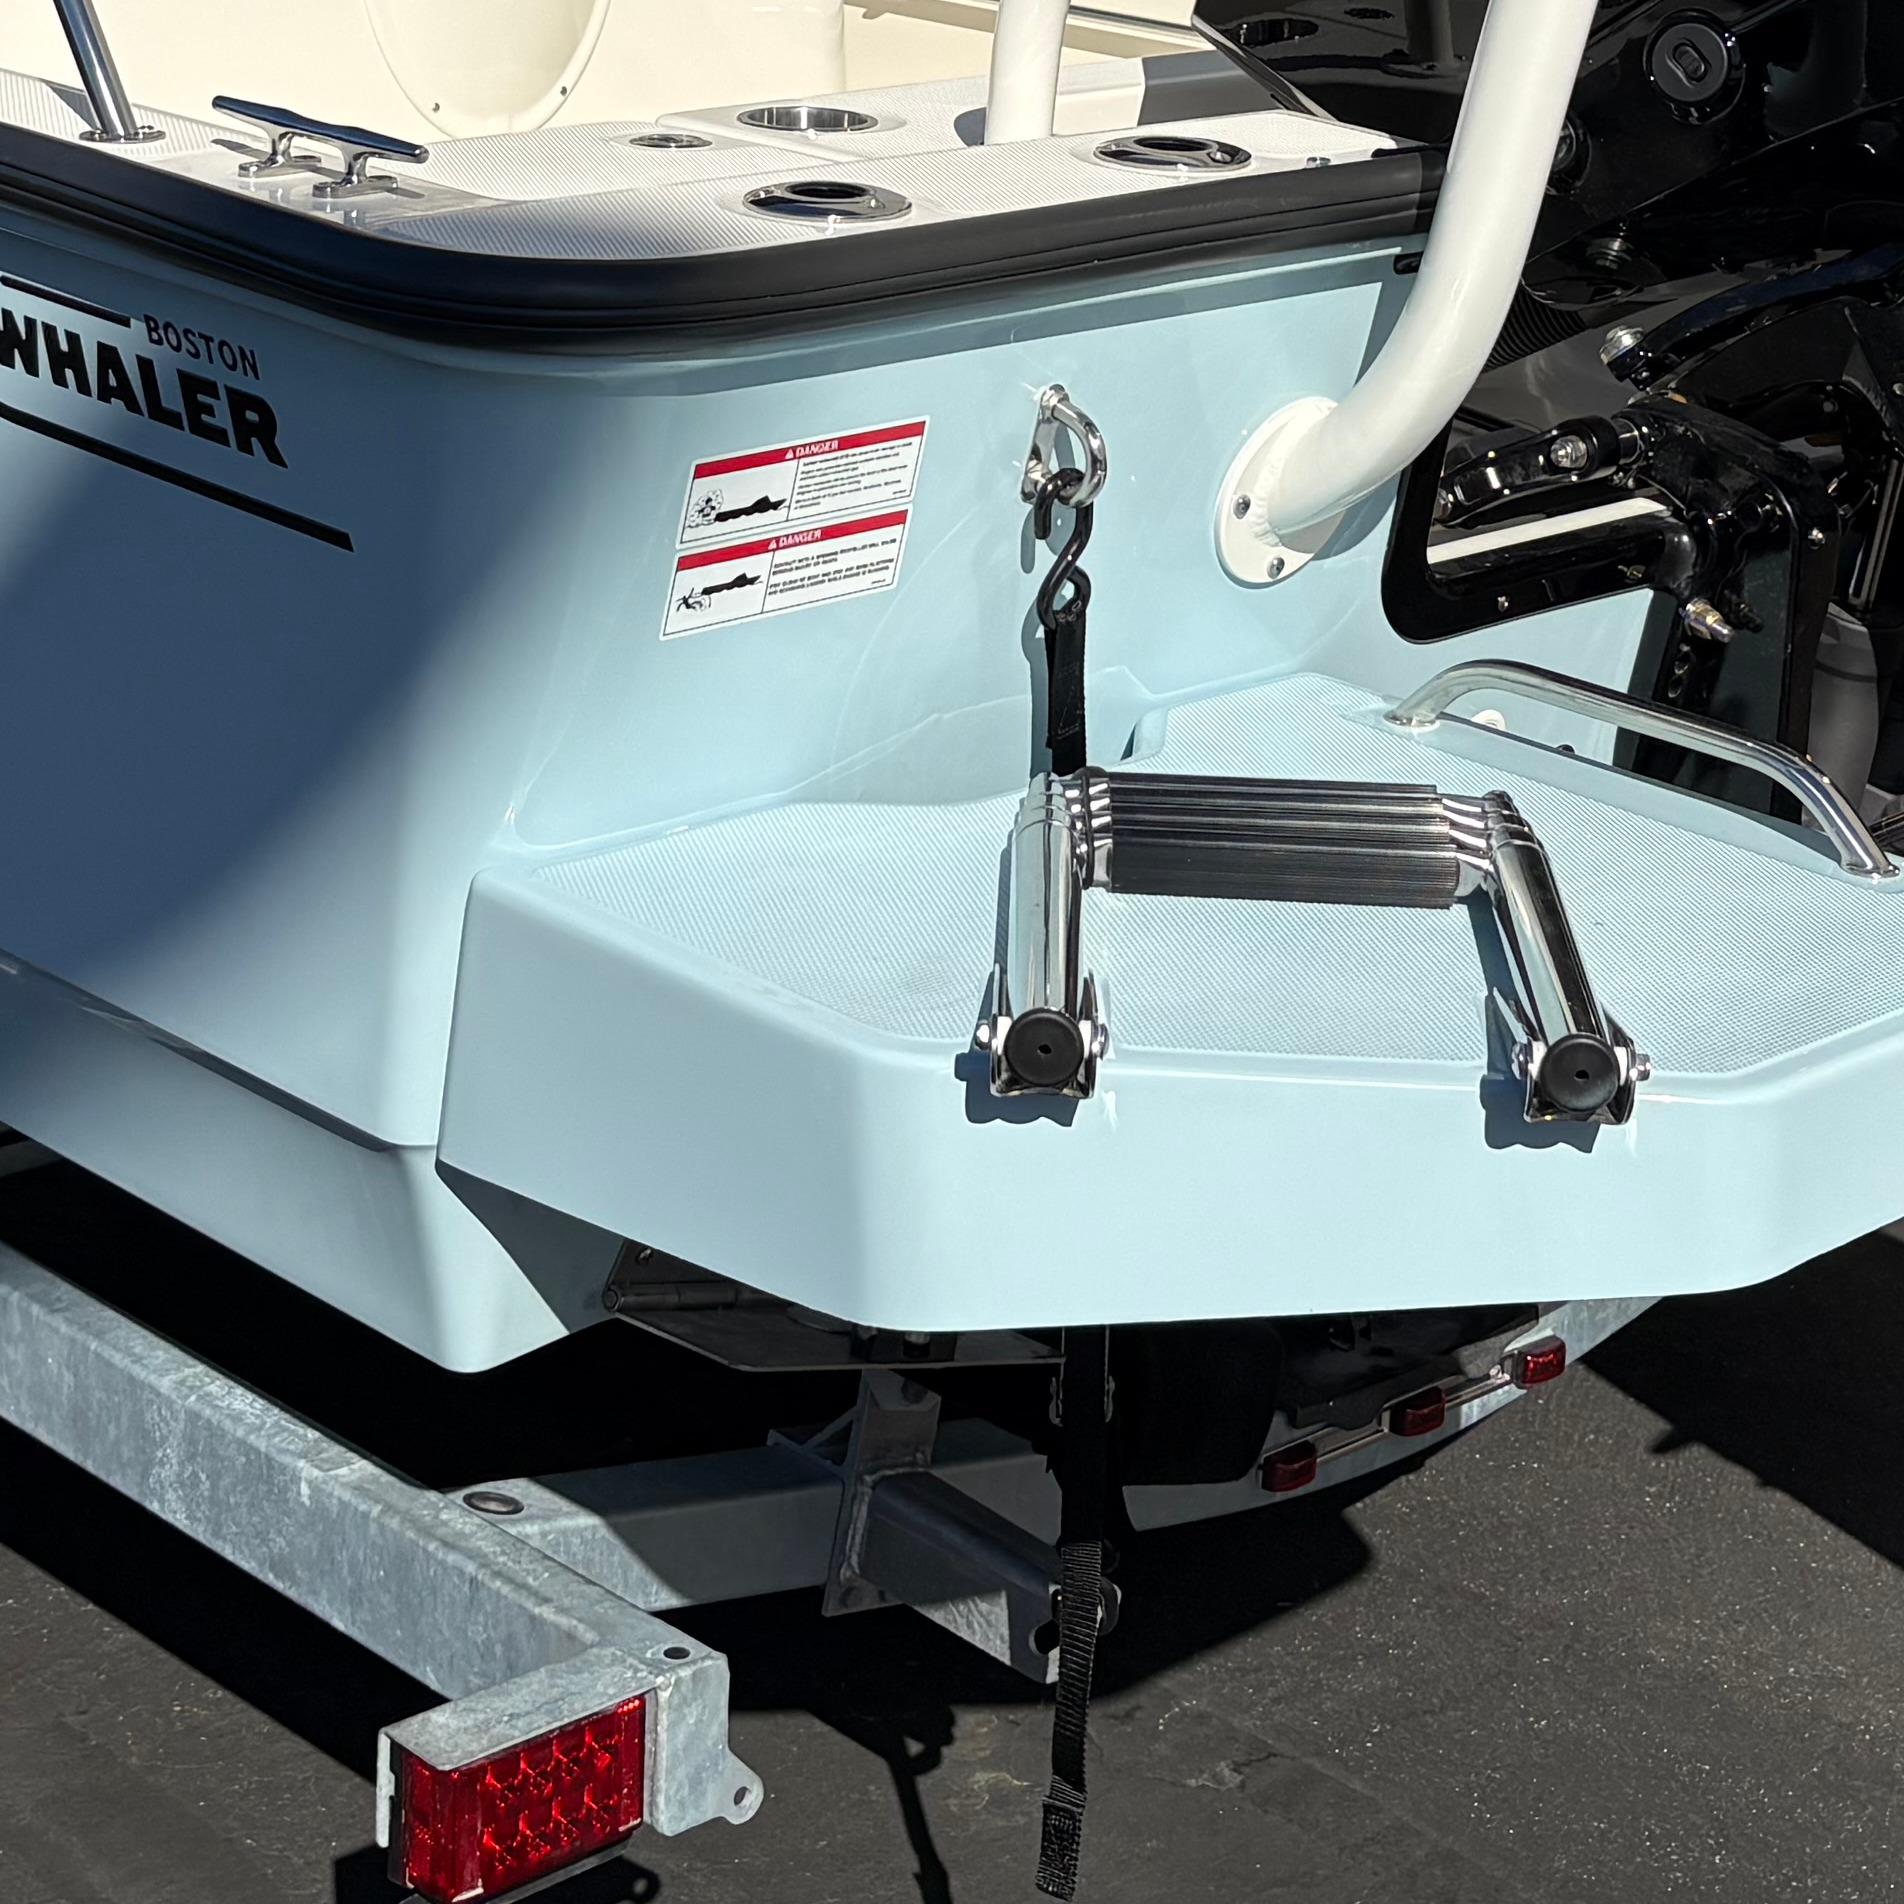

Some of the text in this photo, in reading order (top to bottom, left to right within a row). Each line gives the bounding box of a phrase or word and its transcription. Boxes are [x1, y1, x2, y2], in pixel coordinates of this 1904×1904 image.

[143, 314, 261, 381] BOSTON
[795, 439, 839, 458] DANGER
[778, 529, 822, 548] DANGER
